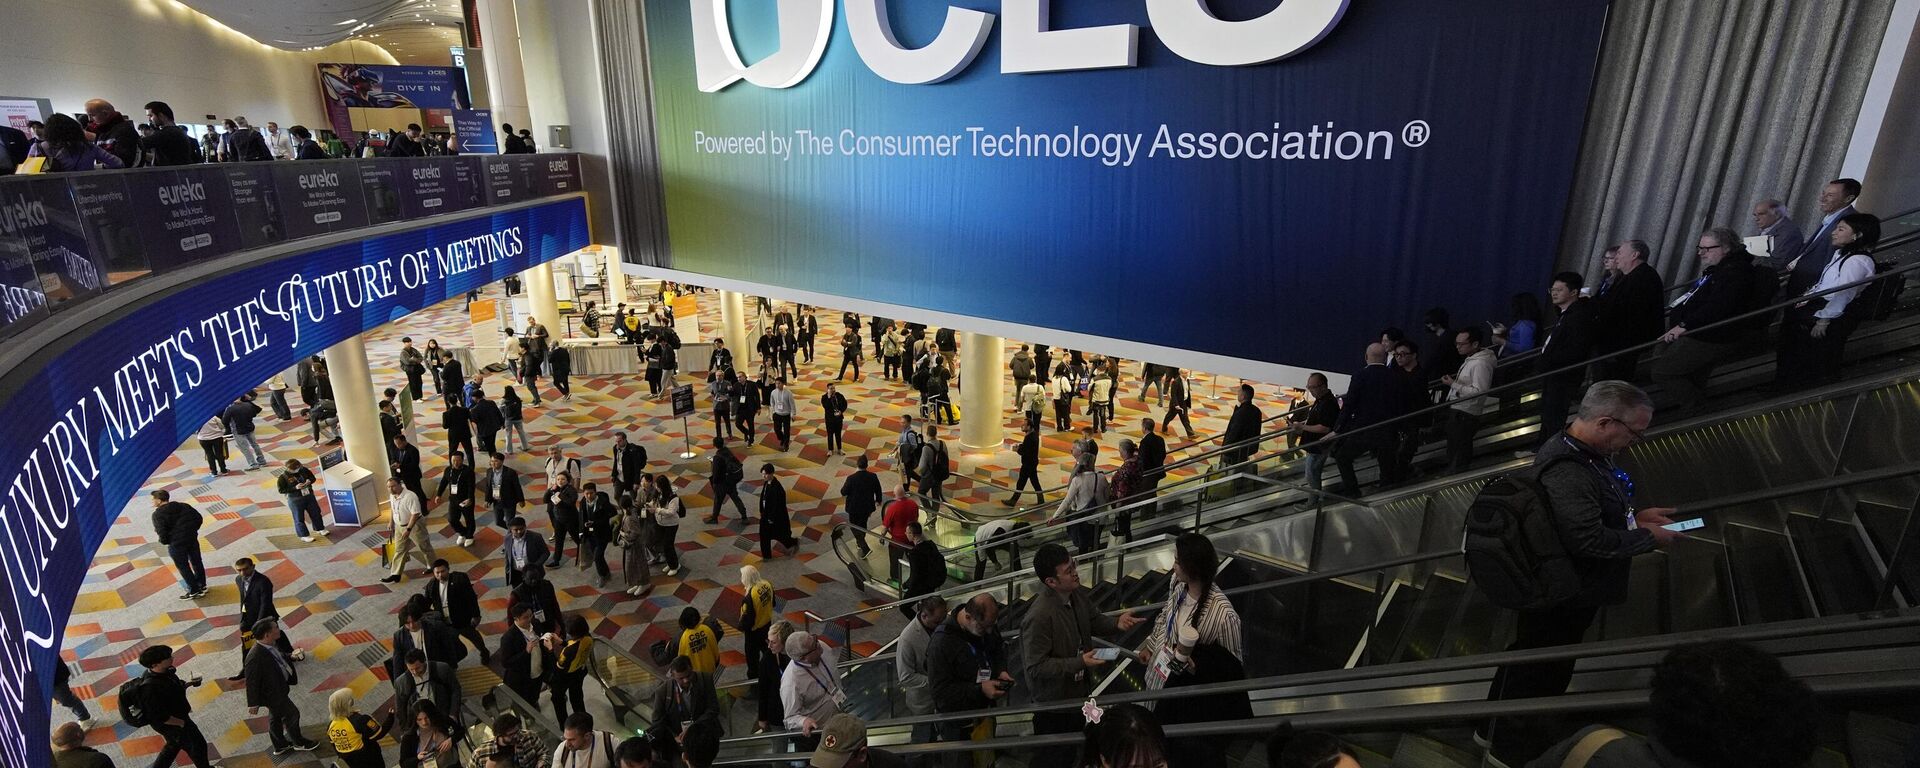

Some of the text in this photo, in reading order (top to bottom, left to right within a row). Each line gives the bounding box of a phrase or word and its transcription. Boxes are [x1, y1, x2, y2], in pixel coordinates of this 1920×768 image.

[455, 56, 465, 67] B
[694, 130, 767, 154] Powered
[770, 131, 793, 162] by
[795, 129, 834, 155] The
[838, 128, 962, 157] Consumer
[966, 126, 1143, 167] Technology
[298, 169, 339, 190] eureka
[412, 163, 441, 180] eureka
[158, 177, 206, 205] eureka
[0, 193, 48, 234] ureka
[0, 225, 524, 673] LUXURY MEETS THE FUTURE OF MEETINGS
[688, 630, 706, 641] CSC
[330, 729, 348, 737] CSC
